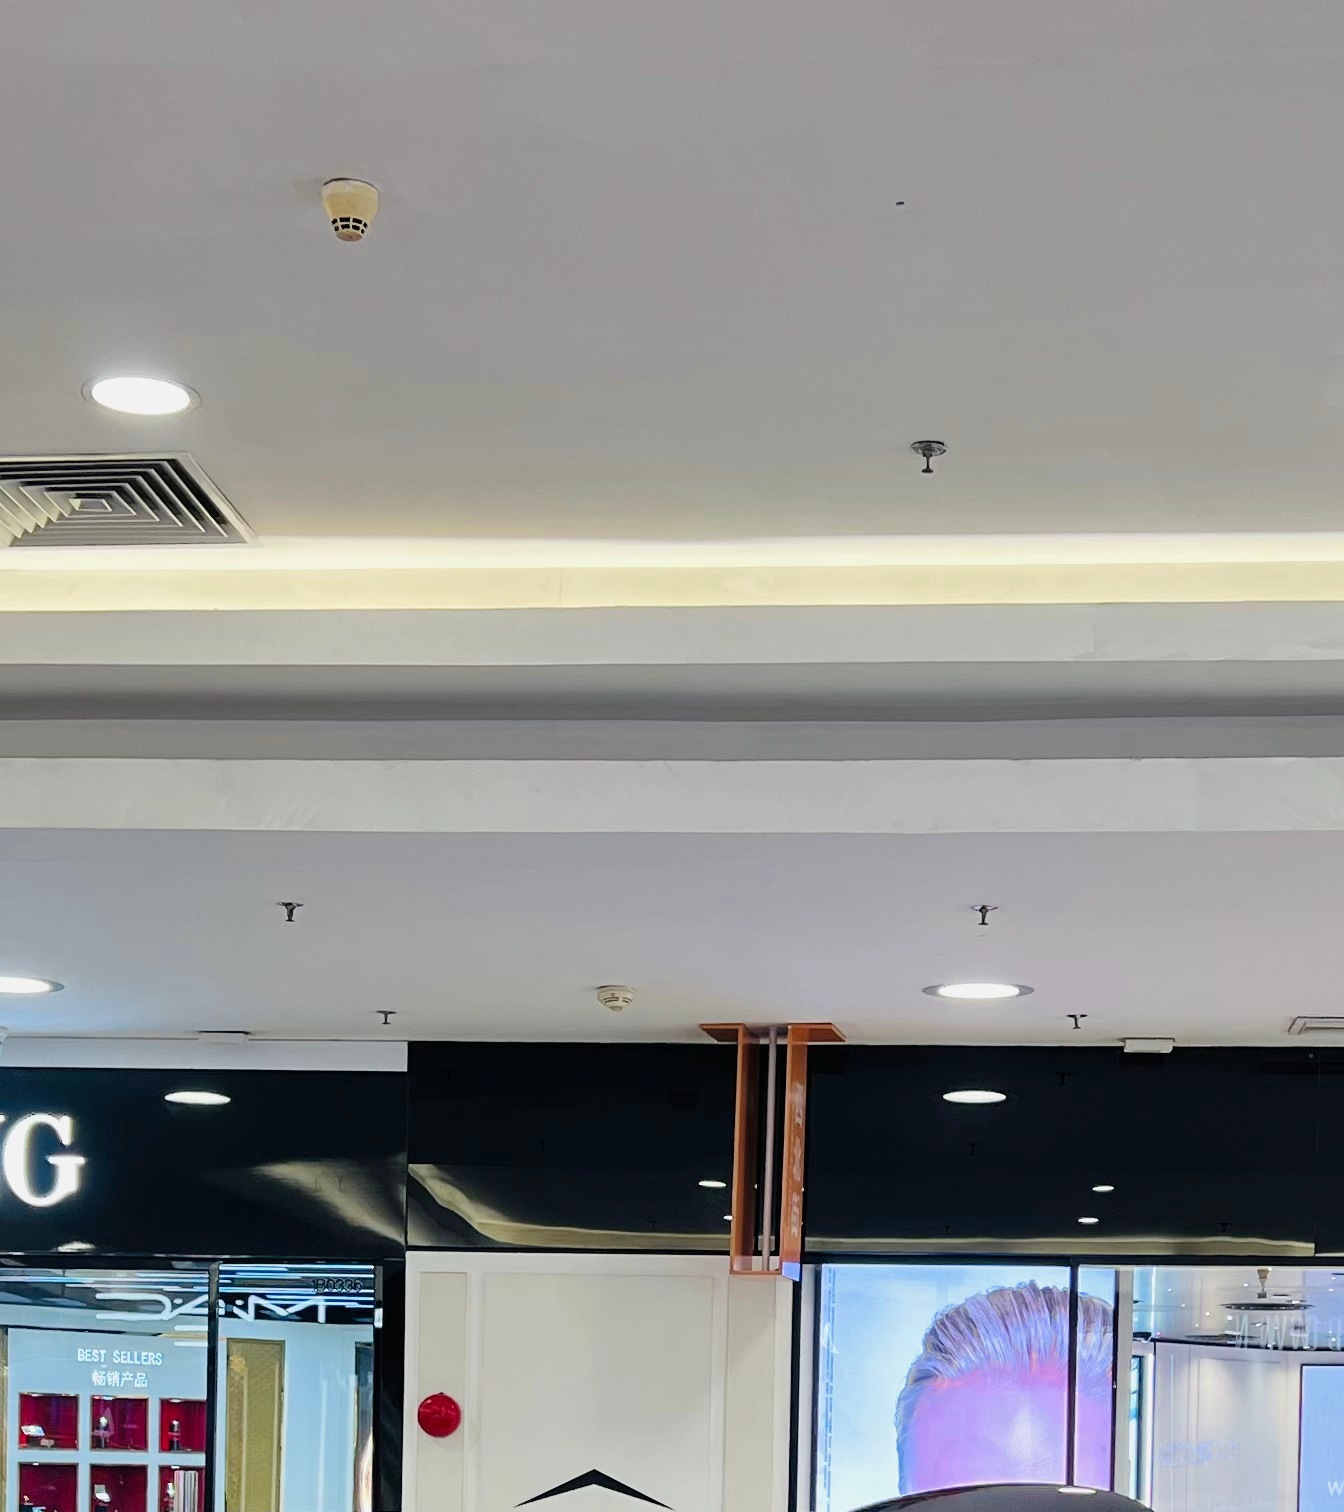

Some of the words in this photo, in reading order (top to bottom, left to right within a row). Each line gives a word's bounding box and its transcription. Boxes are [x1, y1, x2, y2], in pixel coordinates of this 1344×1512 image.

[77, 1348, 107, 1363] BEST
[112, 1350, 163, 1366] SELLERS
[91, 1369, 149, 1389] 畅销产品
